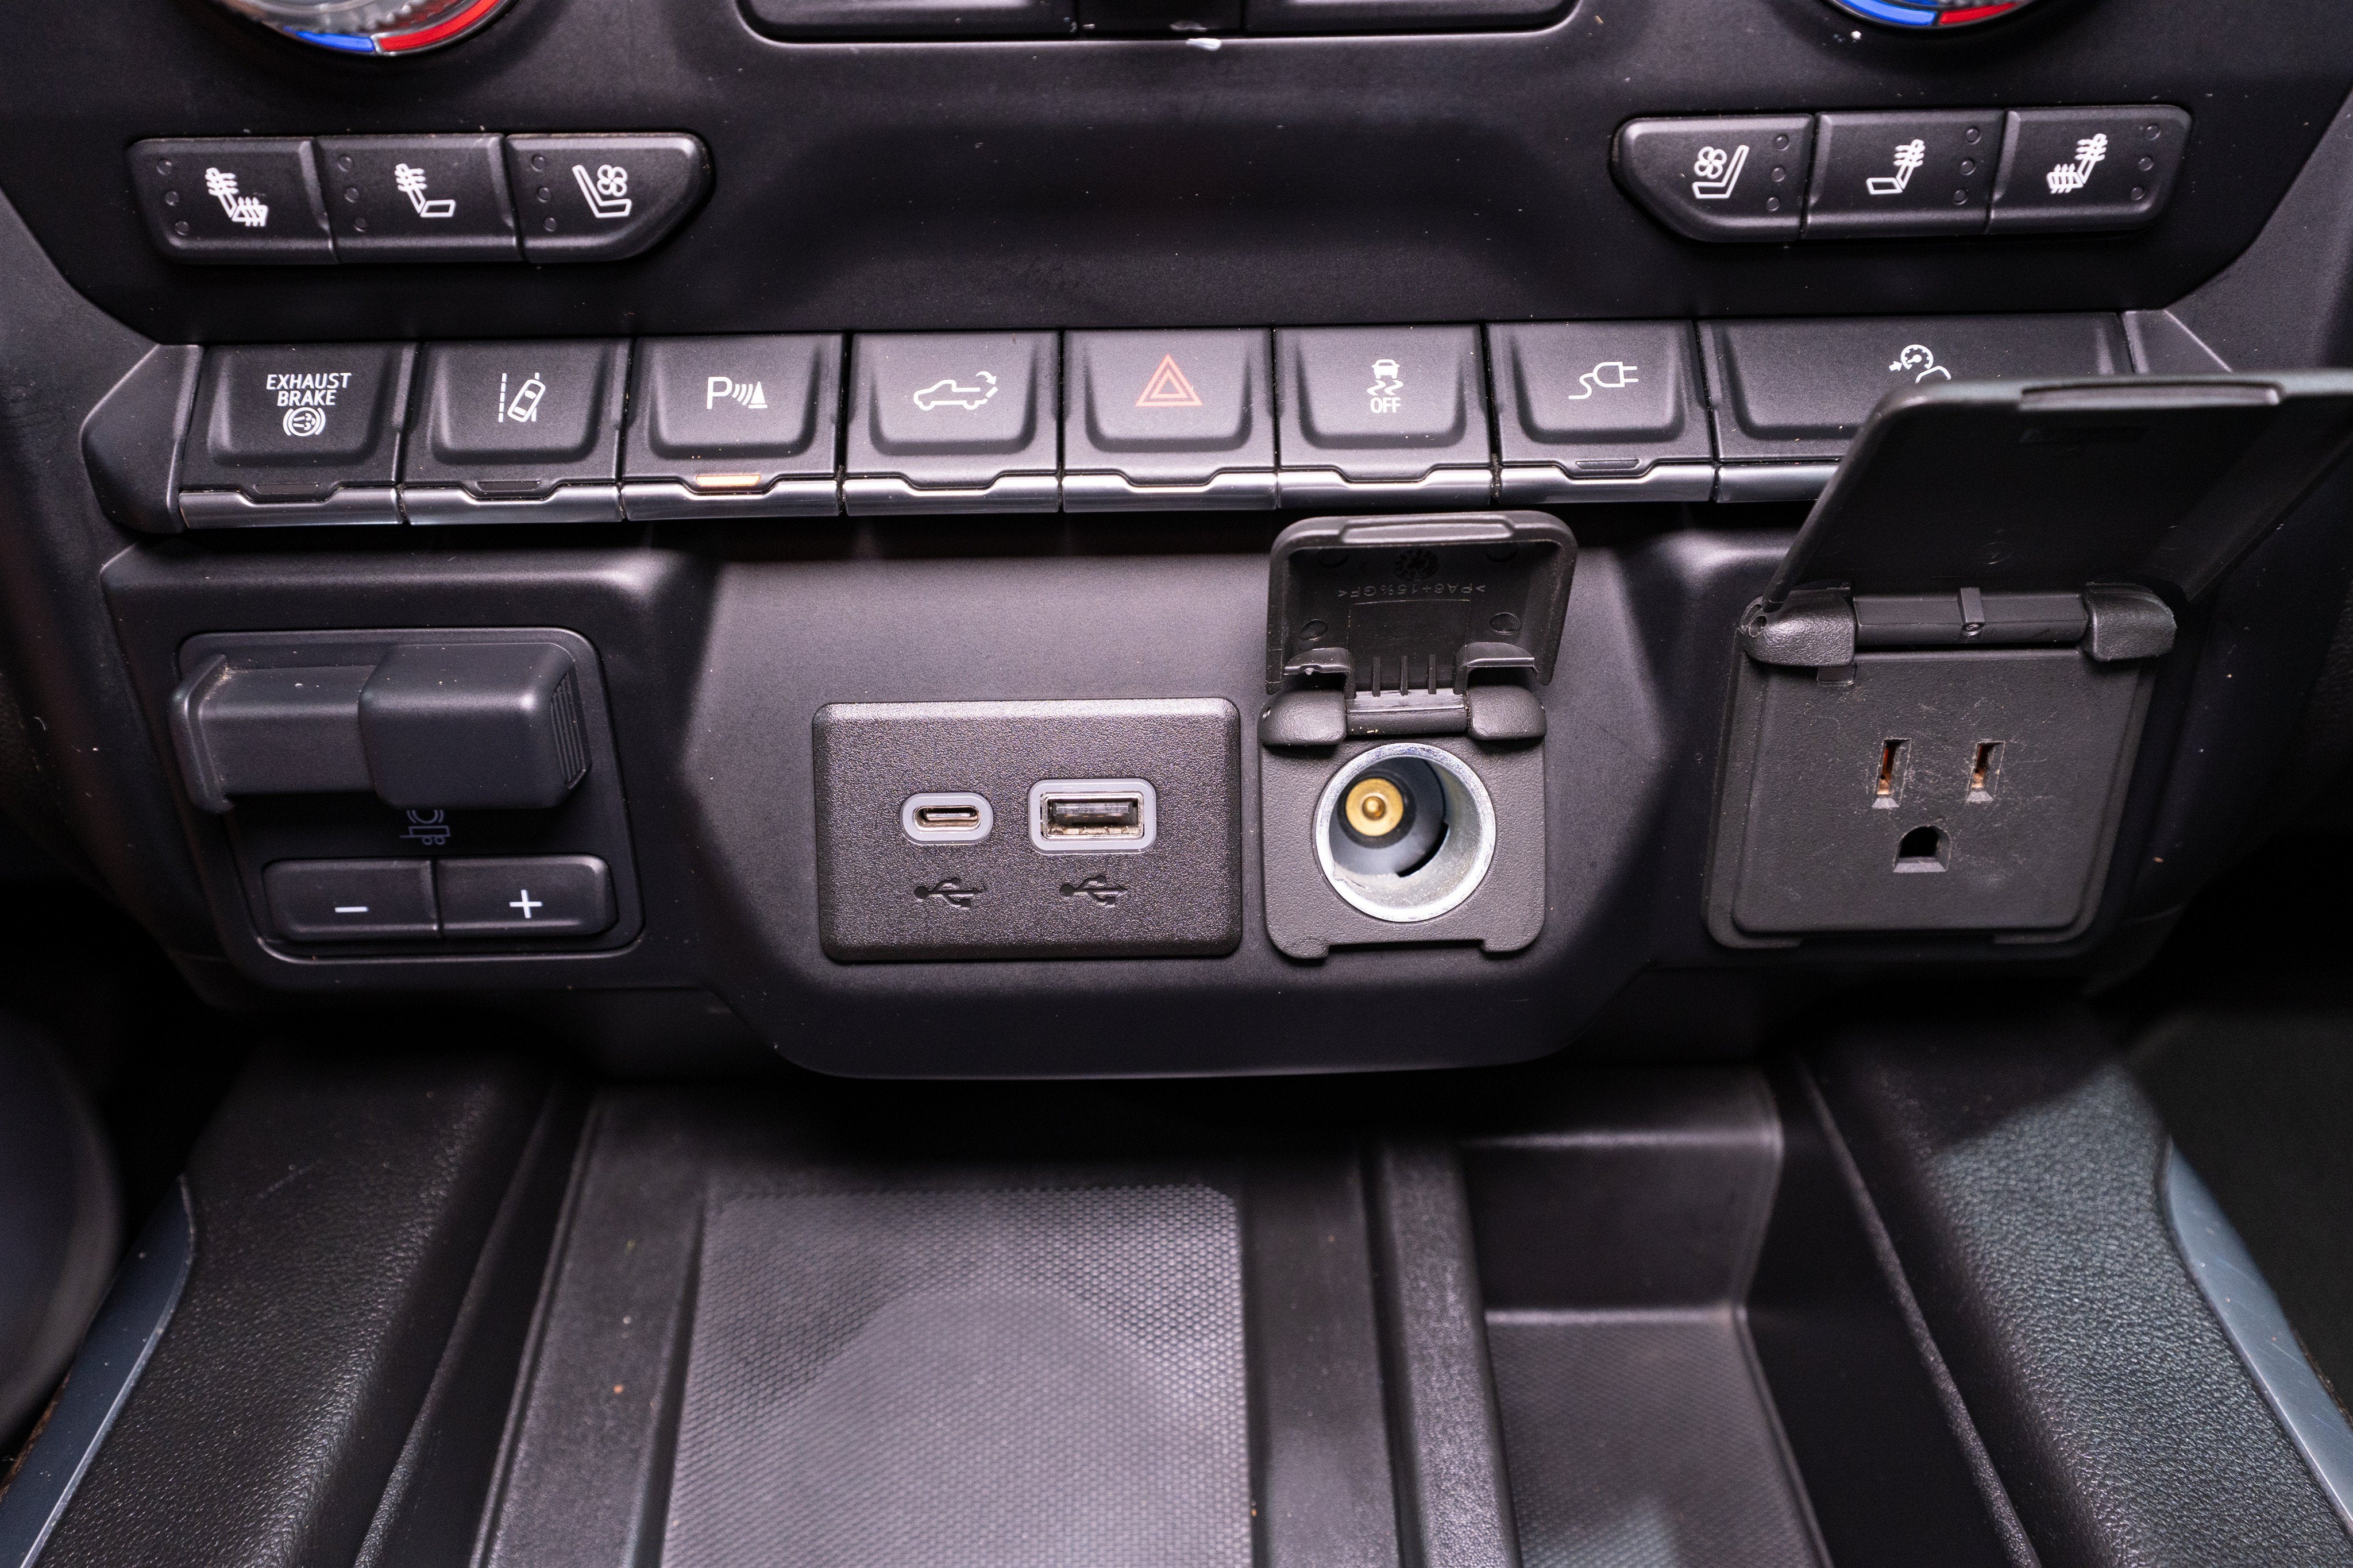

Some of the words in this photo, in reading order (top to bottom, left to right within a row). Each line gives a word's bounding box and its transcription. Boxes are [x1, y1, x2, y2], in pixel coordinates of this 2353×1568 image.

[265, 372, 352, 390] EXHAUST
[277, 389, 338, 407] BRAKE
[1370, 397, 1401, 414] OFF
